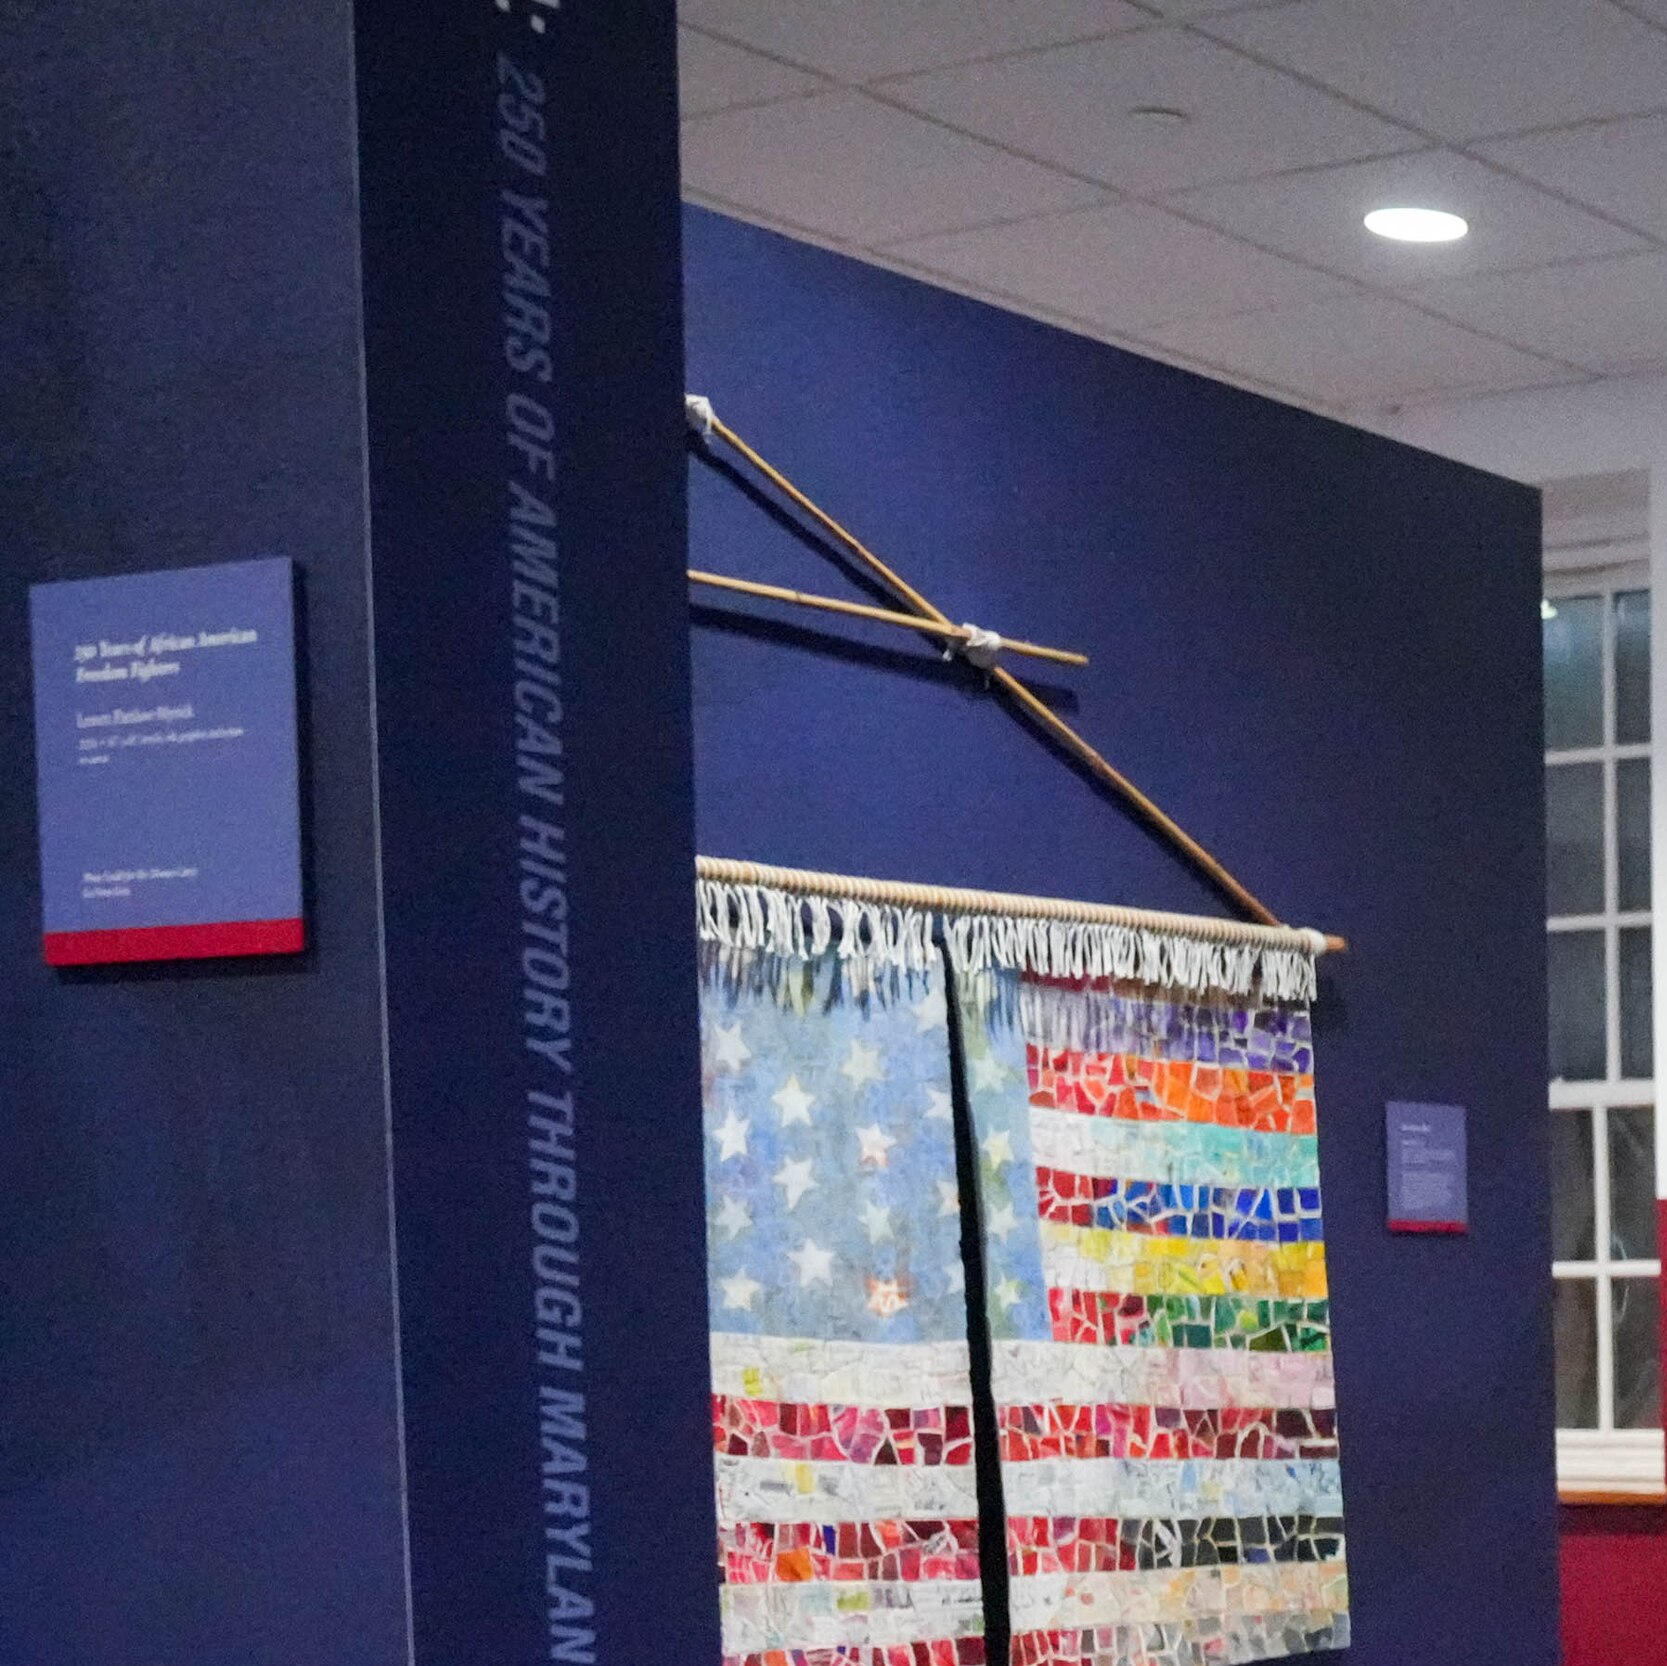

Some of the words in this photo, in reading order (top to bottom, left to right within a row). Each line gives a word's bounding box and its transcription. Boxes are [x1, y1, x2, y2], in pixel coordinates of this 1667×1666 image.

[498, 52, 546, 176] 250
[502, 189, 554, 383] YEARS
[506, 392, 556, 481] OF
[509, 480, 564, 806] AMERICAN
[518, 814, 568, 1072] HISTORY
[526, 1090, 584, 1371] THROUGH
